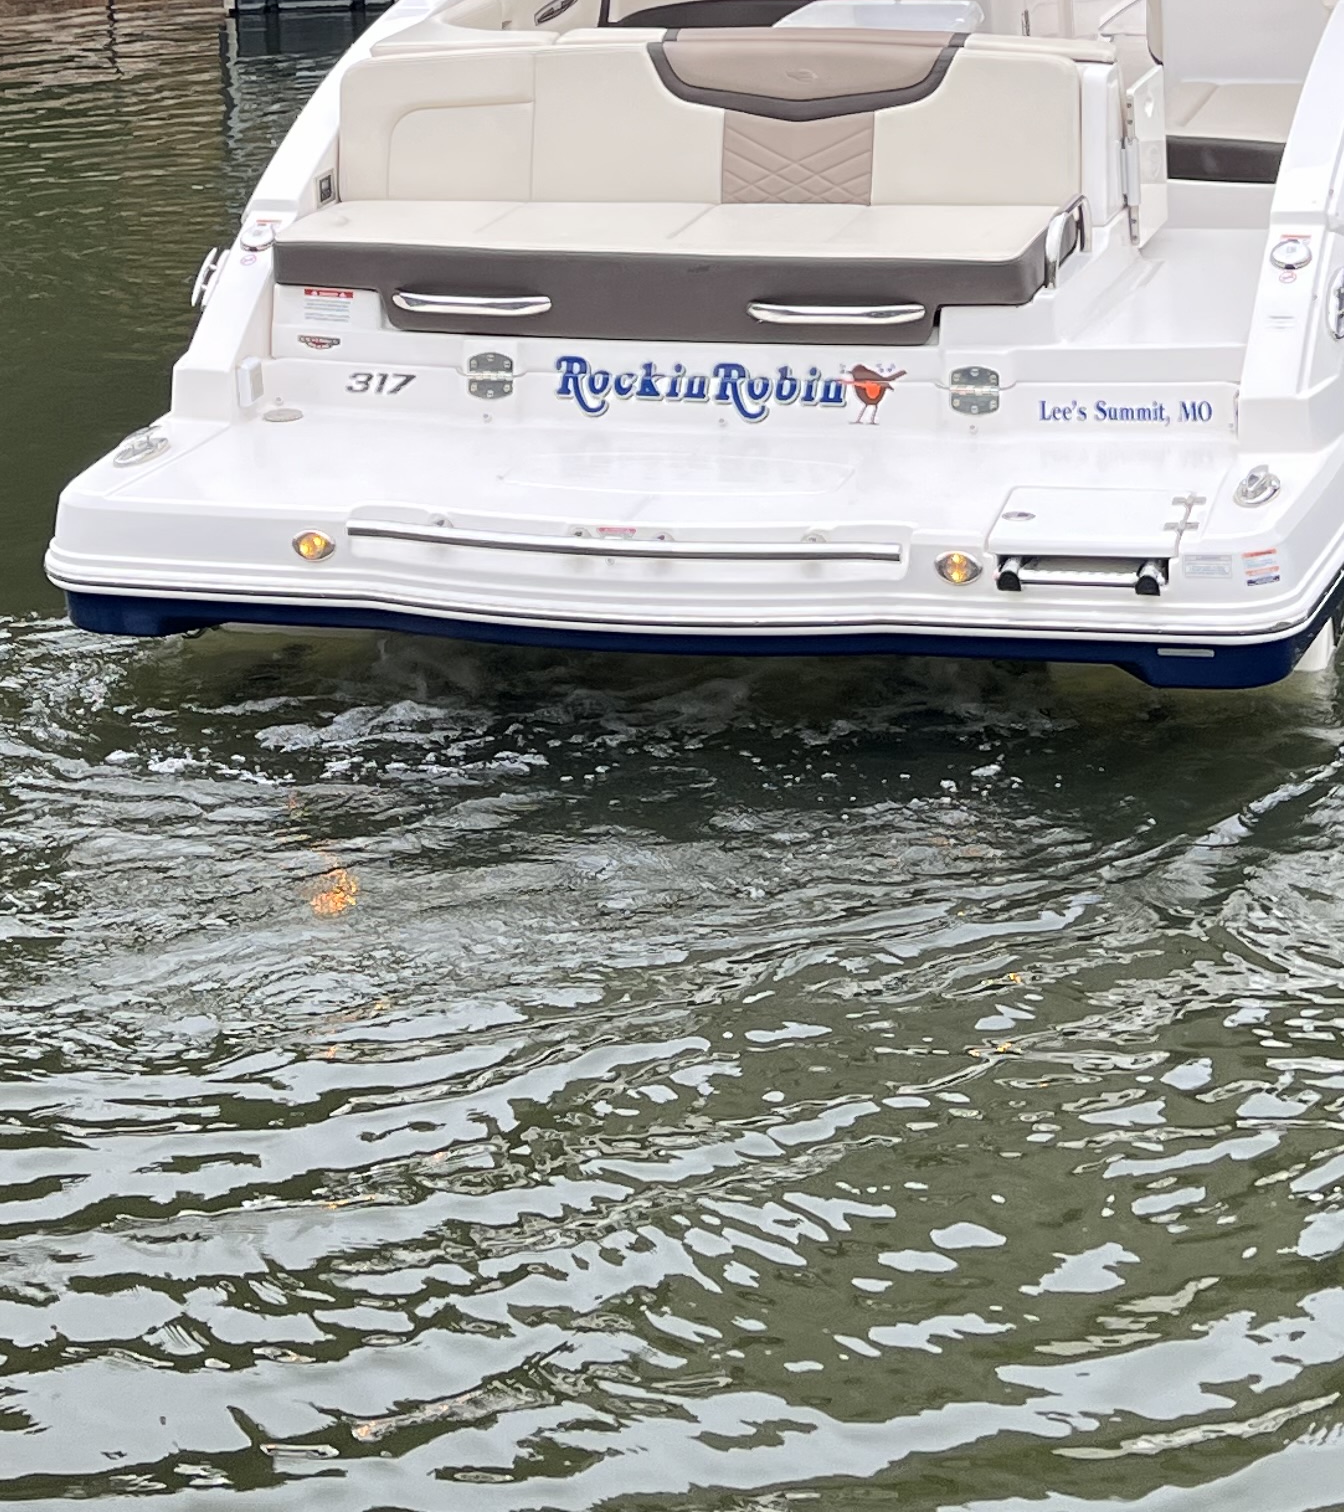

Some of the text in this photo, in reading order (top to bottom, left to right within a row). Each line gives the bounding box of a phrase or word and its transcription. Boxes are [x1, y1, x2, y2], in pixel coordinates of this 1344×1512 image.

[346, 372, 417, 395] 317
[1039, 399, 1213, 427] Lee's Summit, MO
